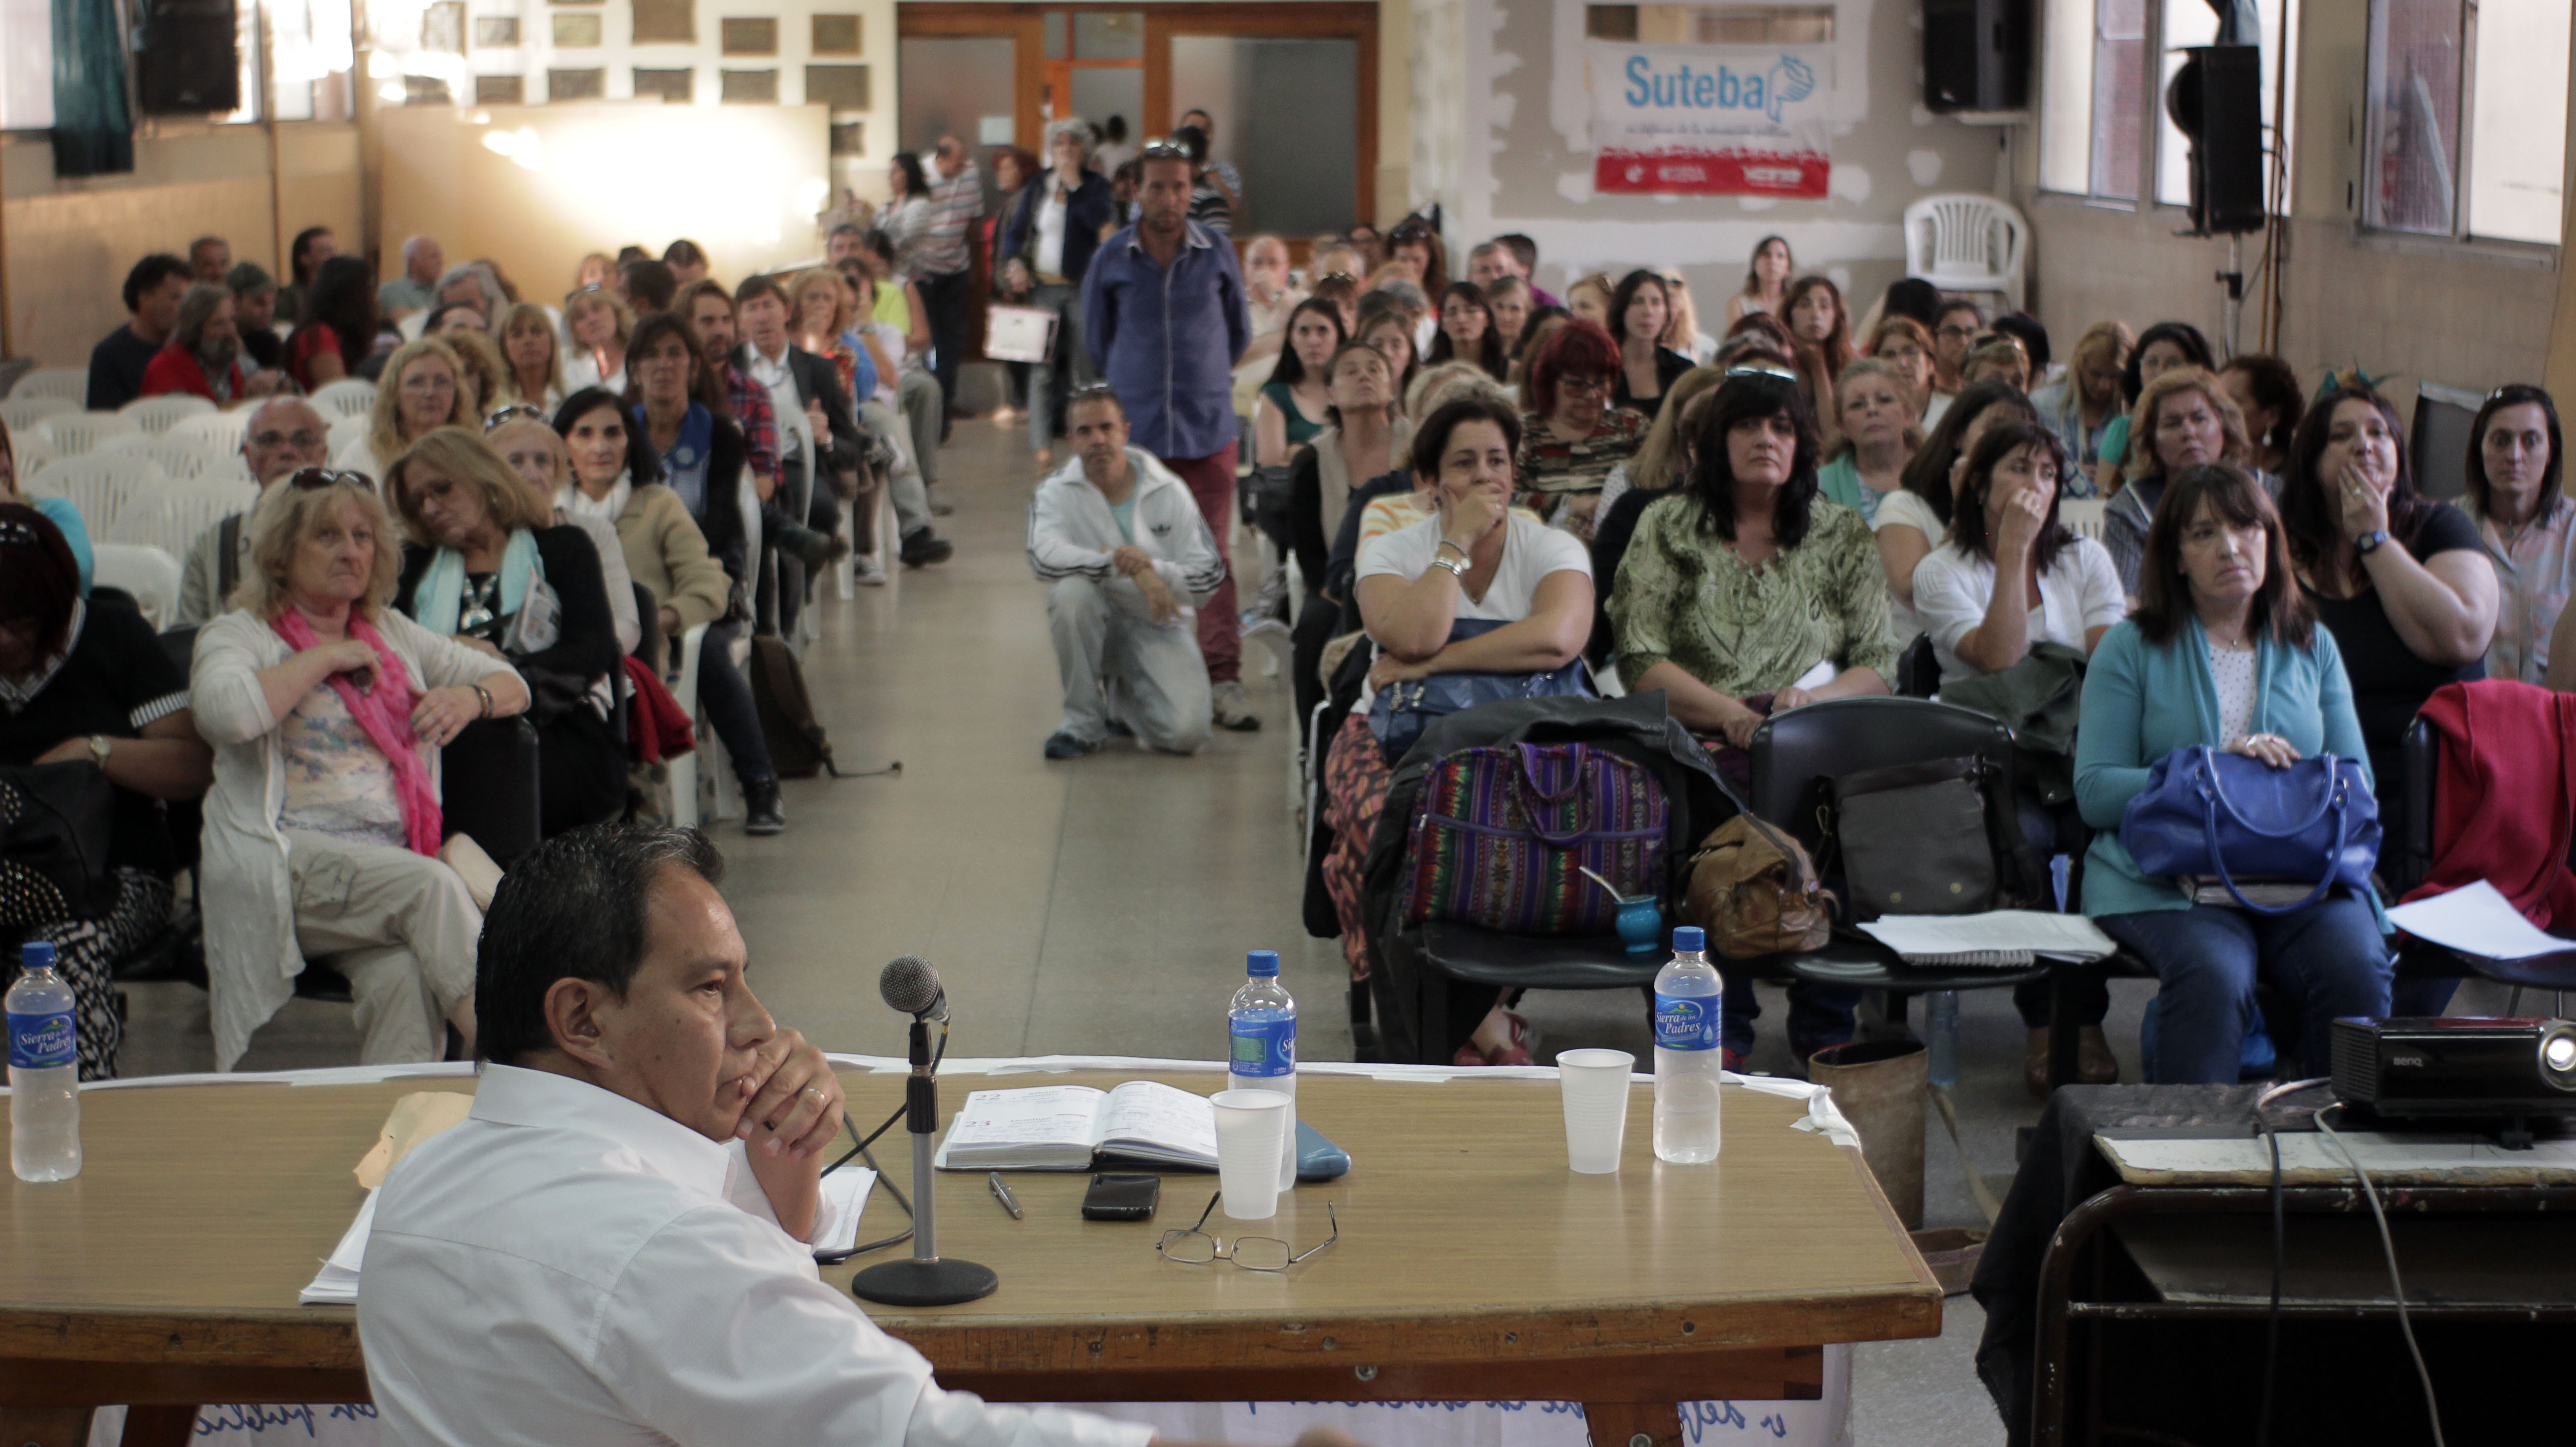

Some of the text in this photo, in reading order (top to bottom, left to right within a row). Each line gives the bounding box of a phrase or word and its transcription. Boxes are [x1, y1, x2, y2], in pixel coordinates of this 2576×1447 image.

[1625, 55, 1765, 109] Suteba
[1656, 1012, 1679, 1023] Sierra
[1665, 1022, 1700, 1034] Padres
[20, 1032, 55, 1045] Sierra
